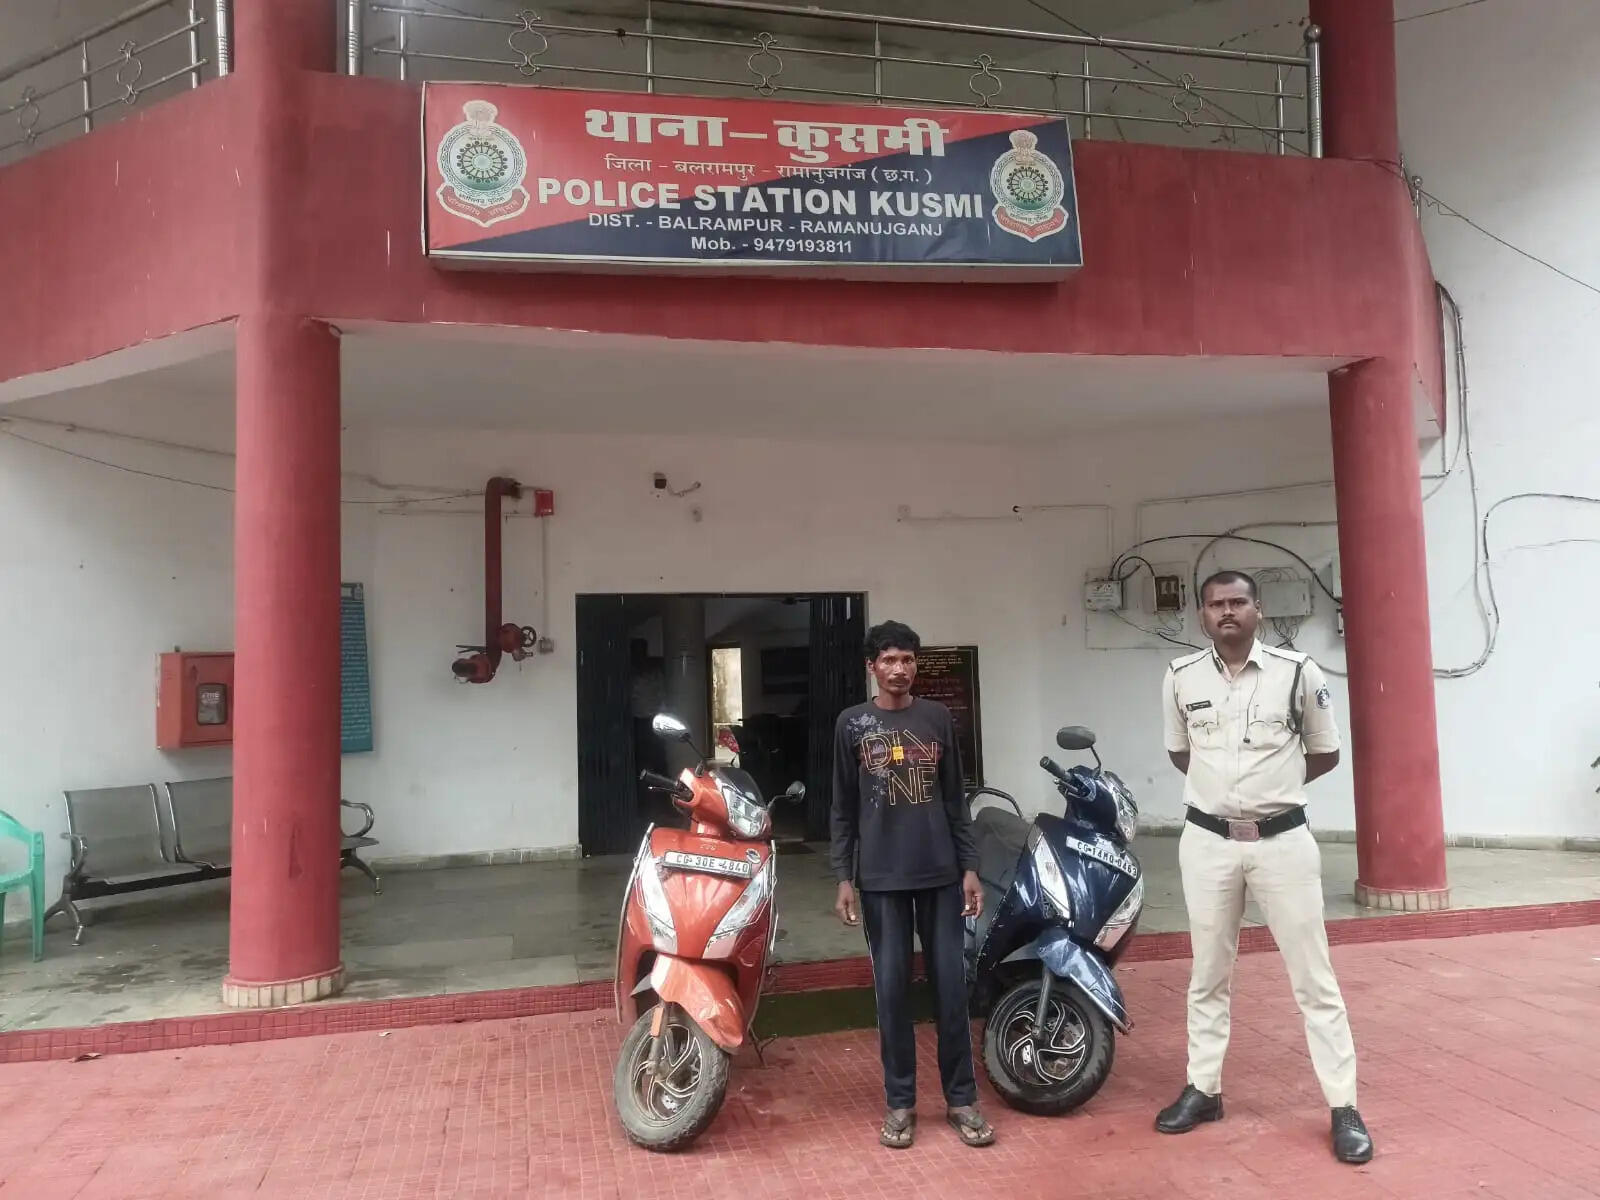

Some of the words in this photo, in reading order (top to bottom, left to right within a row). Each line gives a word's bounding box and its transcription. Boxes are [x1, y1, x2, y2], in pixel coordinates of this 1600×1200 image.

[603, 152, 653, 172] जिला
[672, 159, 756, 182] बलरामपुर
[775, 163, 867, 184] रामानुजगंज
[537, 177, 681, 210] POLICE
[693, 184, 857, 216] STATION
[868, 189, 984, 219] KUSMI
[588, 212, 641, 228] DIST.
[658, 215, 785, 233] BALRAMPUR
[800, 219, 943, 237] RAMANUJGANJ
[690, 235, 737, 251] Mob.
[752, 237, 853, 254] 9479193811
